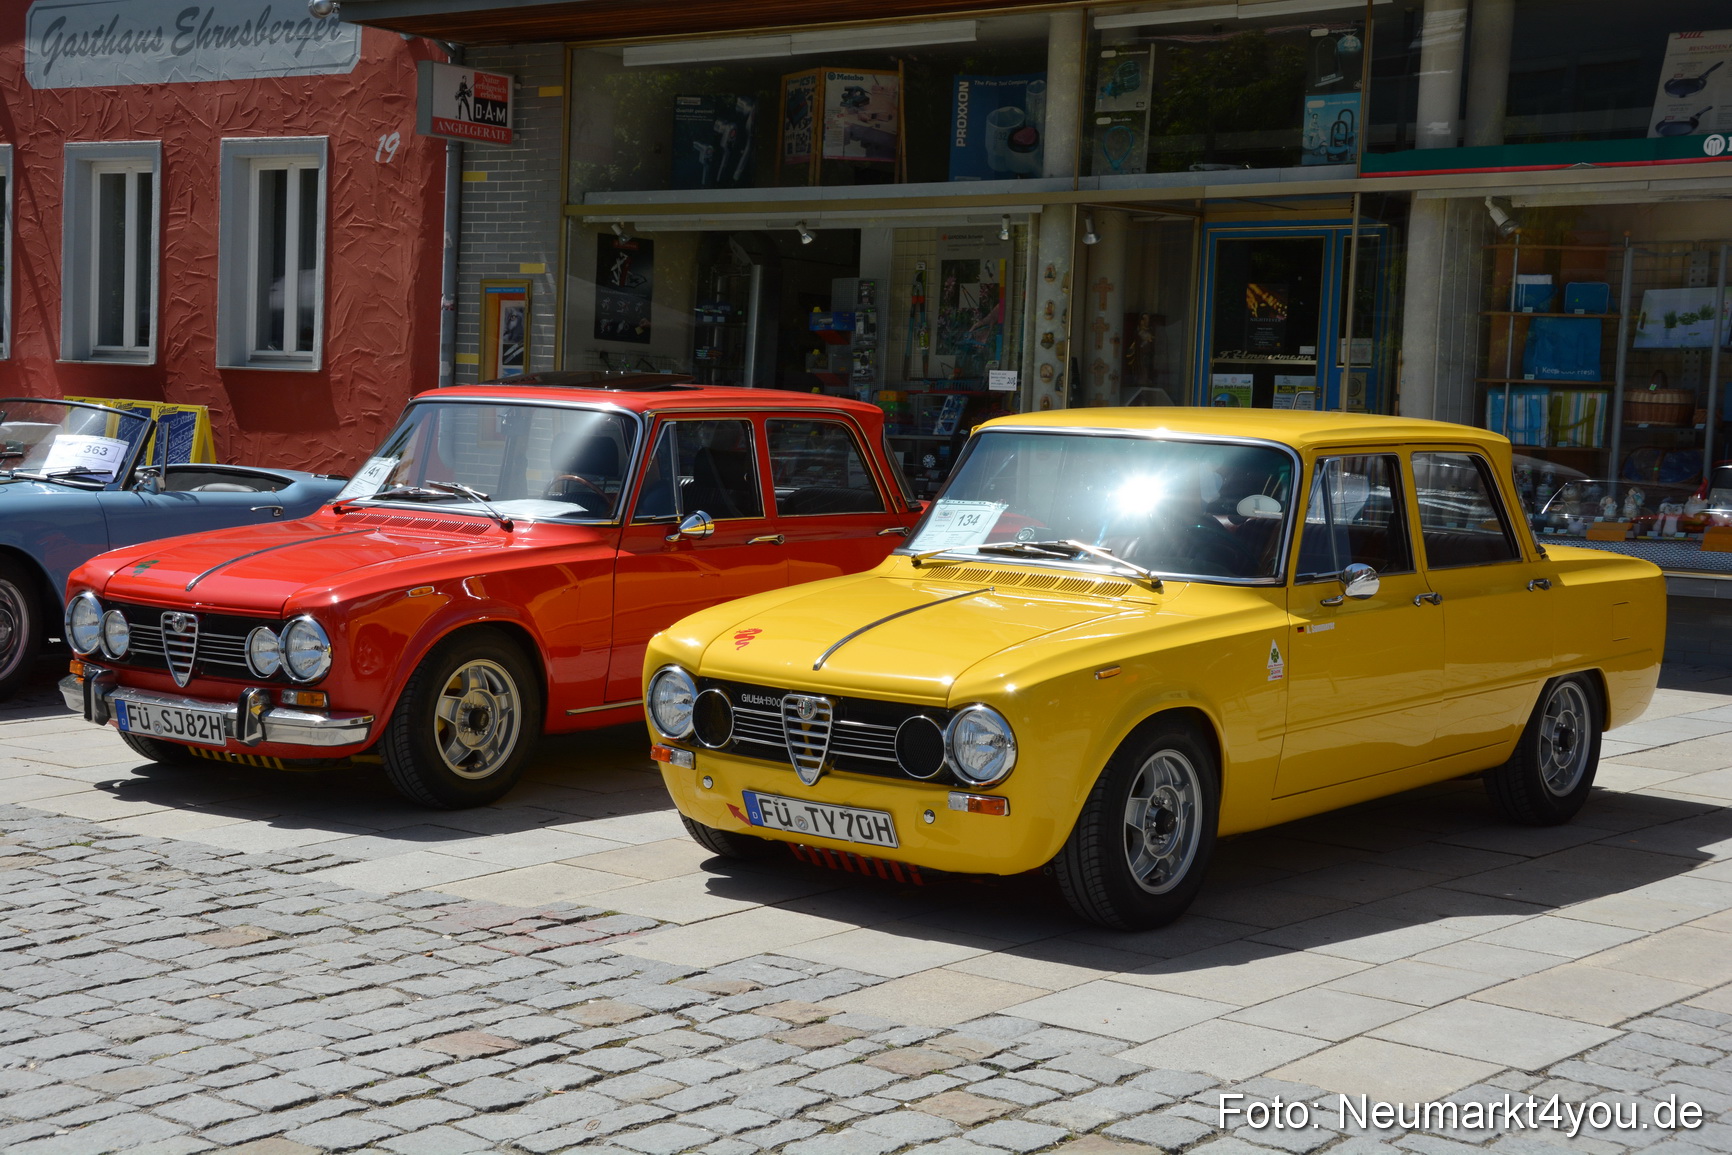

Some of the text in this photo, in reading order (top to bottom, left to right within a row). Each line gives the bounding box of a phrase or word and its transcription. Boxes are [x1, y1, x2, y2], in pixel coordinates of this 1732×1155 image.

[42, 4, 342, 76] Gasthaus Ehrnsberger
[482, 74, 500, 84] Natur
[836, 73, 864, 81] Metabo
[475, 82, 507, 95] erfolgreich
[480, 92, 503, 101] erleben
[956, 81, 969, 147] PROXXON
[437, 121, 507, 140] ANGELGERÄTE
[375, 131, 401, 164] 19
[1542, 366, 1560, 375] Keep
[83, 444, 109, 456] 363
[957, 514, 981, 527] 134
[126, 704, 222, 741] FÜ SJ82H
[752, 811, 759, 820] D
[758, 798, 894, 843] FÜ TY70H
